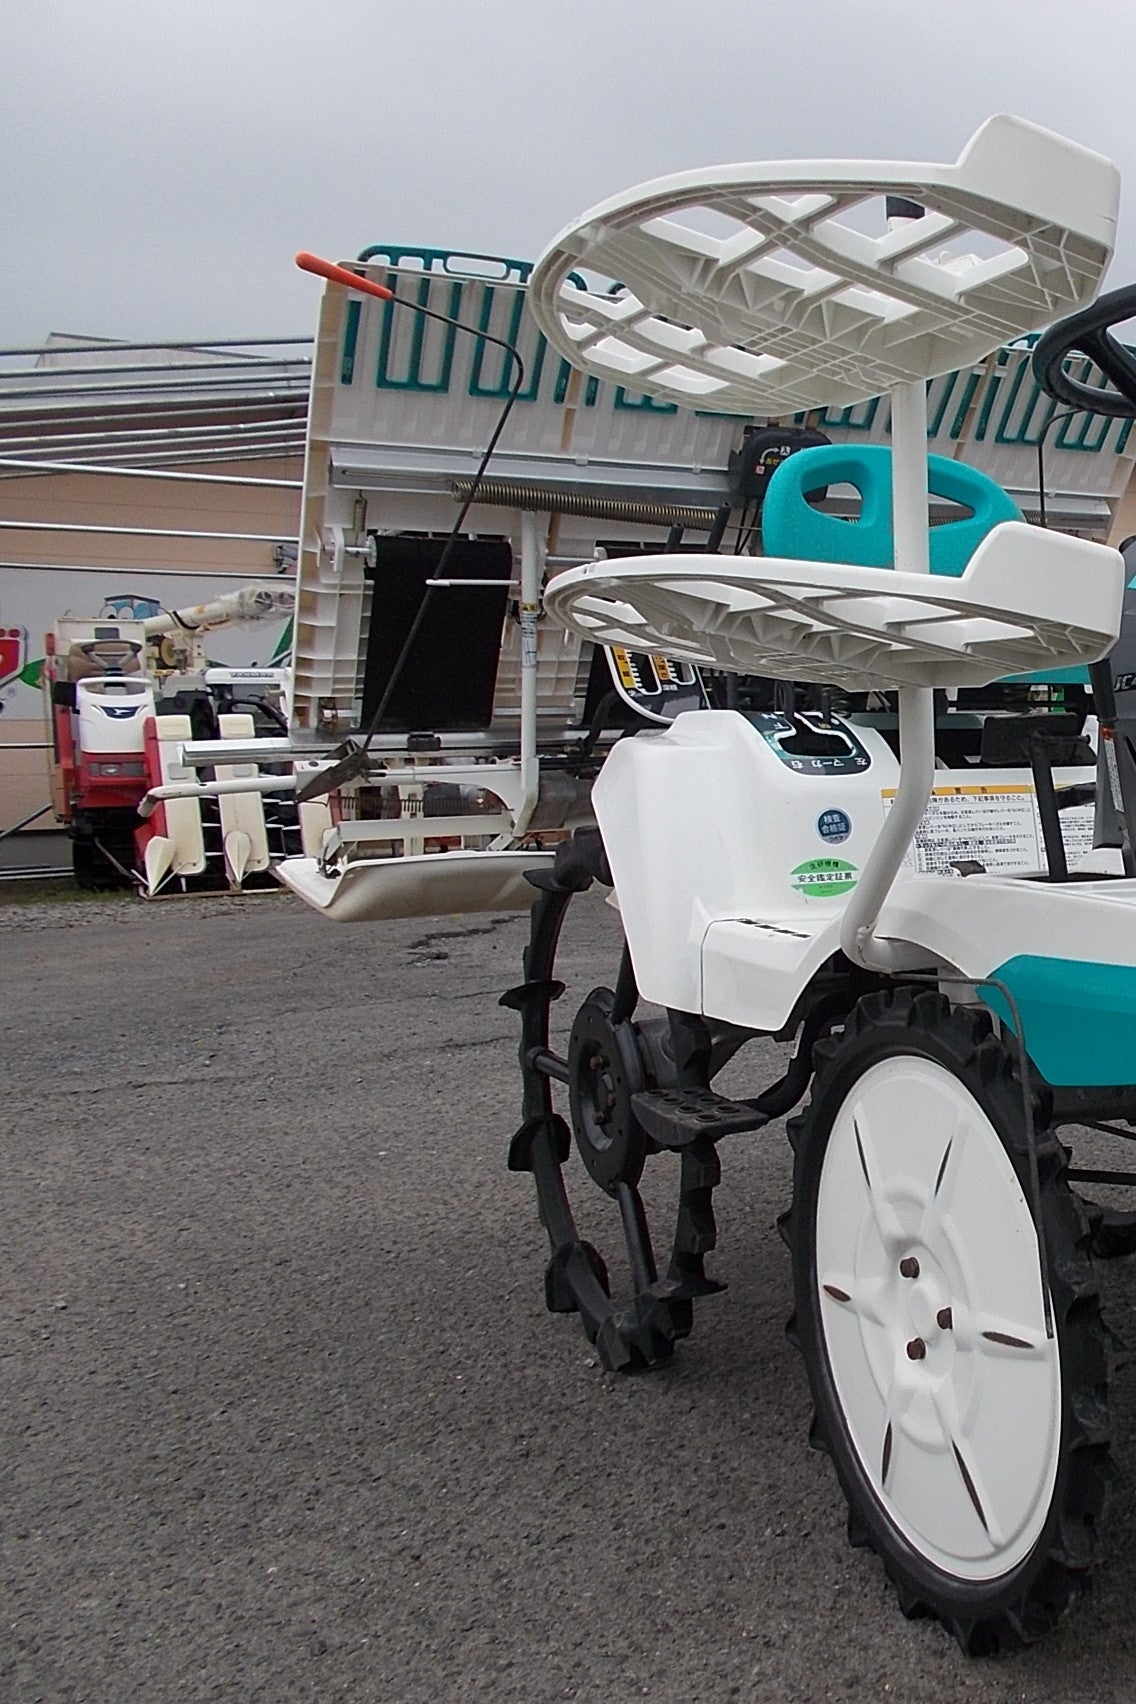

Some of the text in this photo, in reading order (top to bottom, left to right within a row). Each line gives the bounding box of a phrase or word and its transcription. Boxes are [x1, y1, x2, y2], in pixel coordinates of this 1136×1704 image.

[790, 760, 804, 769] 右
[811, 758, 845, 768] マーカ
[823, 813, 841, 824] 検査
[820, 822, 847, 834] 合格証
[797, 872, 853, 883] 安全鑑定証票
